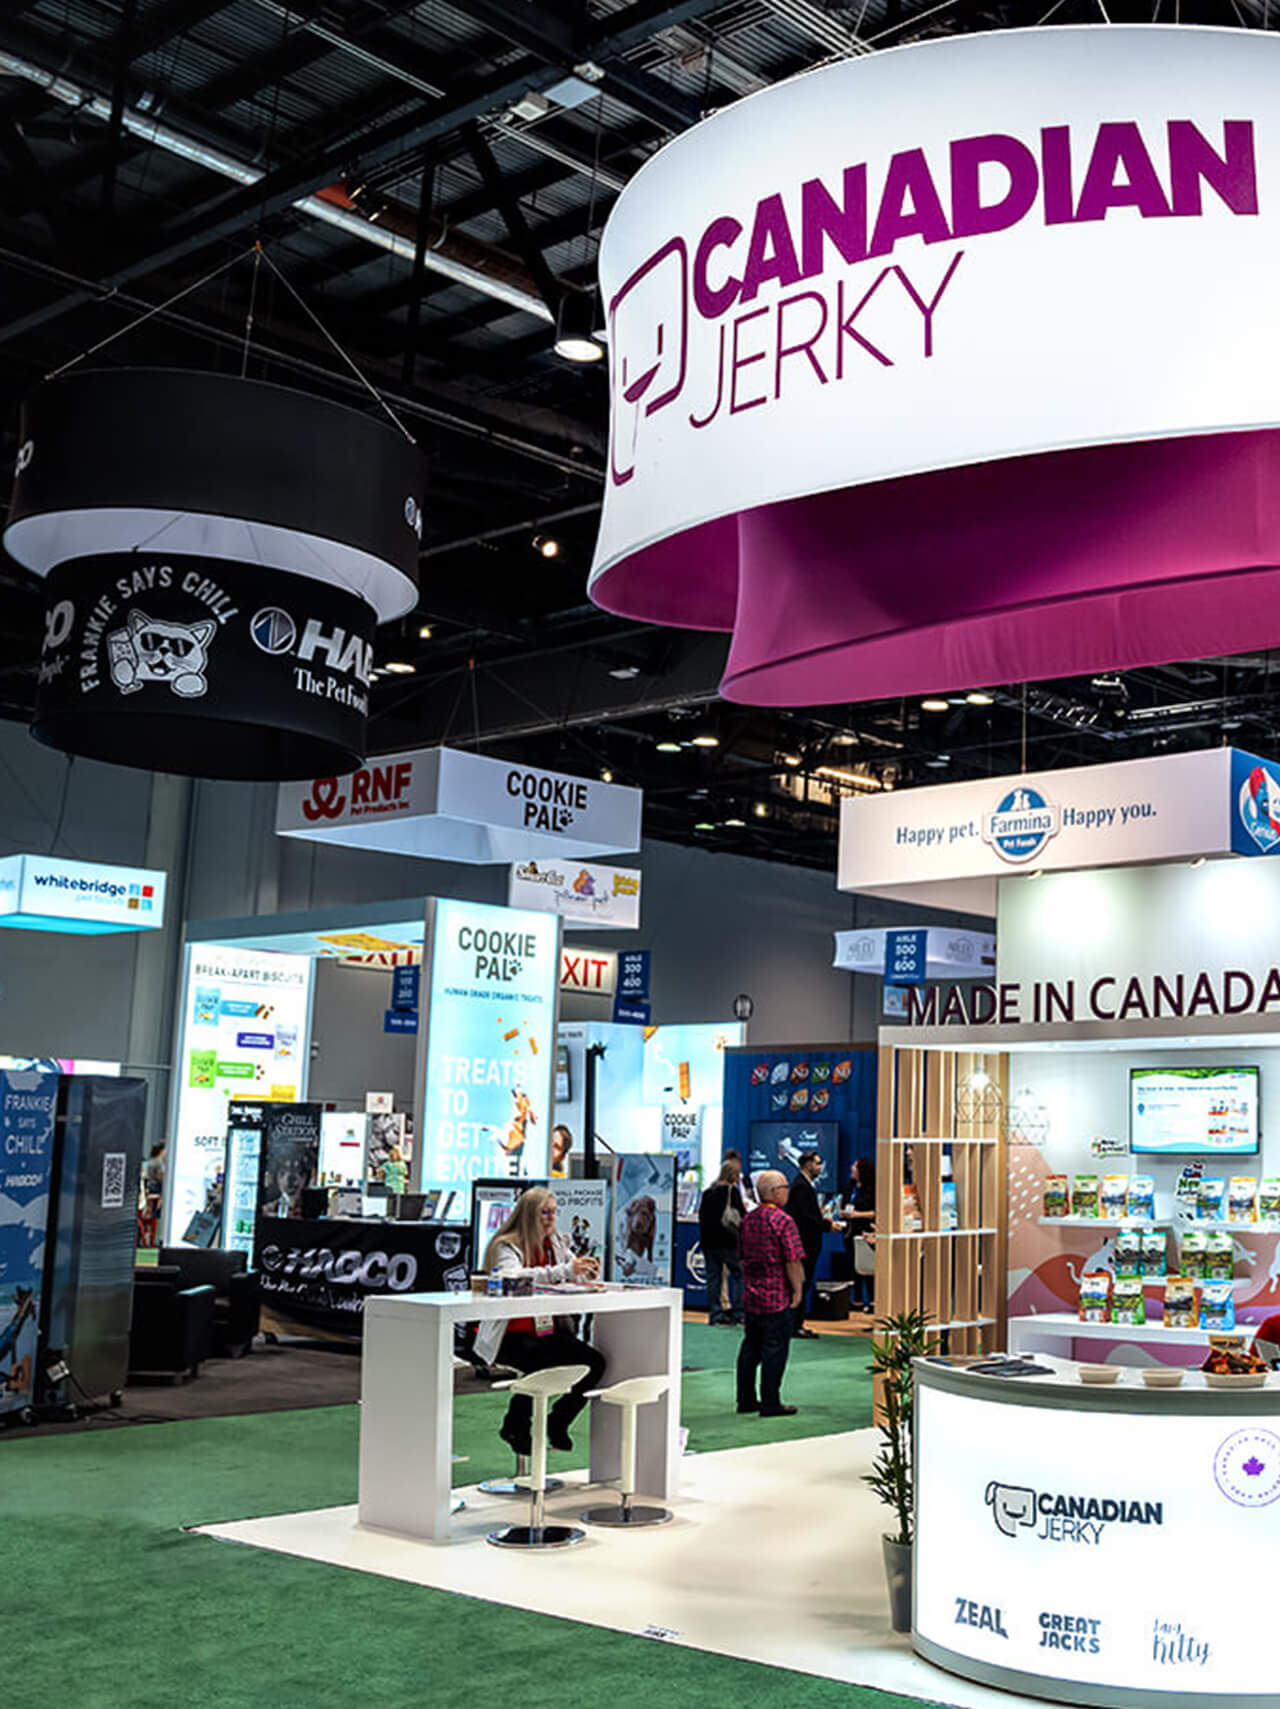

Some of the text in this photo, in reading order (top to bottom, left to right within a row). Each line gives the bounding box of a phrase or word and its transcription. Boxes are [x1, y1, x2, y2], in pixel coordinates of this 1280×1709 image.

[693, 119, 1259, 319] CANADIAN
[689, 250, 964, 429] JERKY
[80, 595, 118, 692] FRANKIE
[116, 566, 174, 599] SAYS
[181, 571, 239, 625] CHILL
[293, 666, 325, 696] The
[351, 762, 413, 804] RNF
[507, 769, 588, 810] COOKIE
[524, 802, 562, 832] PAL
[991, 812, 1052, 834] Farmina
[1062, 803, 1157, 830] Happy you.
[896, 821, 980, 847] Happy pet.
[34, 873, 127, 898] whitebridge
[458, 926, 536, 957] COOKIE
[475, 955, 513, 982] PAL
[561, 955, 609, 989] XIT
[906, 983, 1021, 1027] MADE
[1033, 980, 1075, 1023] IN
[440, 1056, 528, 1085] TREATS
[5, 1095, 50, 1112] FRANKIE
[440, 1088, 469, 1115] TO
[663, 1113, 697, 1126] COOKIE
[5, 1135, 44, 1154] CHILL
[194, 1136, 219, 1147] SOFT
[438, 1121, 483, 1148] GET
[436, 1154, 530, 1180] EXCITE
[1038, 1492, 1163, 1525] CANADIAN
[1037, 1519, 1106, 1546] JERKY
[954, 1597, 1010, 1640] ZEAL
[1038, 1611, 1102, 1636] GREAT
[1039, 1630, 1102, 1655] JACKS
